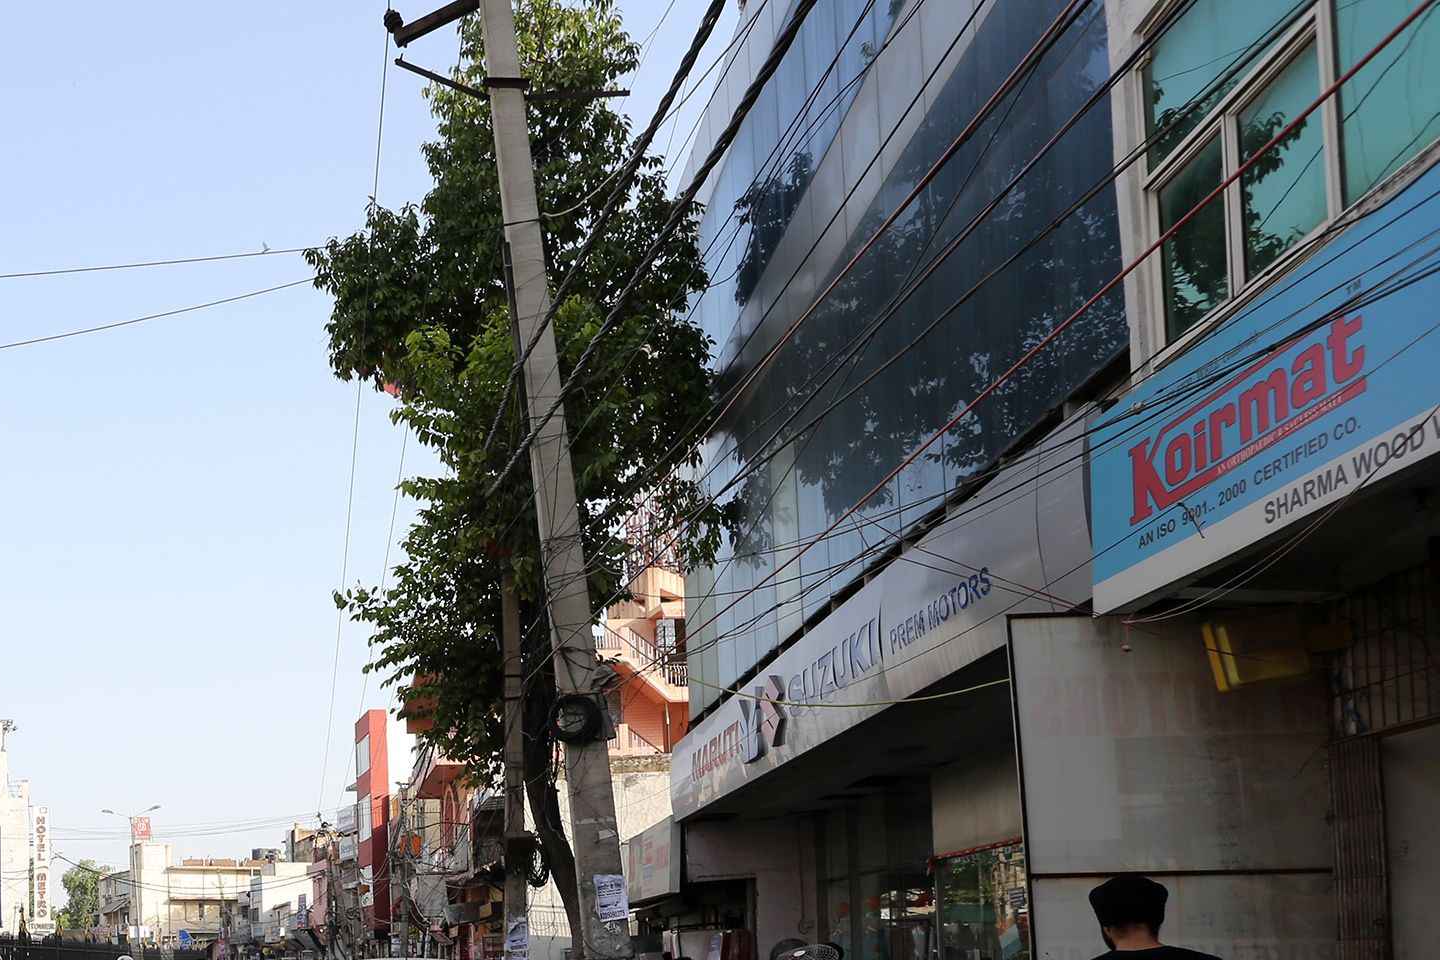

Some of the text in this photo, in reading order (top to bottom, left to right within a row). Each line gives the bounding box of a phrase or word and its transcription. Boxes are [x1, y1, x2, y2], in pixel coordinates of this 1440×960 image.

[1129, 314, 1366, 527] Koirmat
[1138, 533, 1154, 549] AN
[1156, 519, 1176, 540] ISO
[1218, 479, 1247, 506] 2000
[1253, 433, 1329, 486] CERTIFIED
[1264, 464, 1349, 524] SHARMA
[1352, 424, 1426, 480] WOOD
[888, 566, 992, 655] PREM MOTORS
[787, 617, 880, 718] SUZUKI
[691, 719, 742, 782] MARUTI
[36, 816, 47, 862] HOTEL
